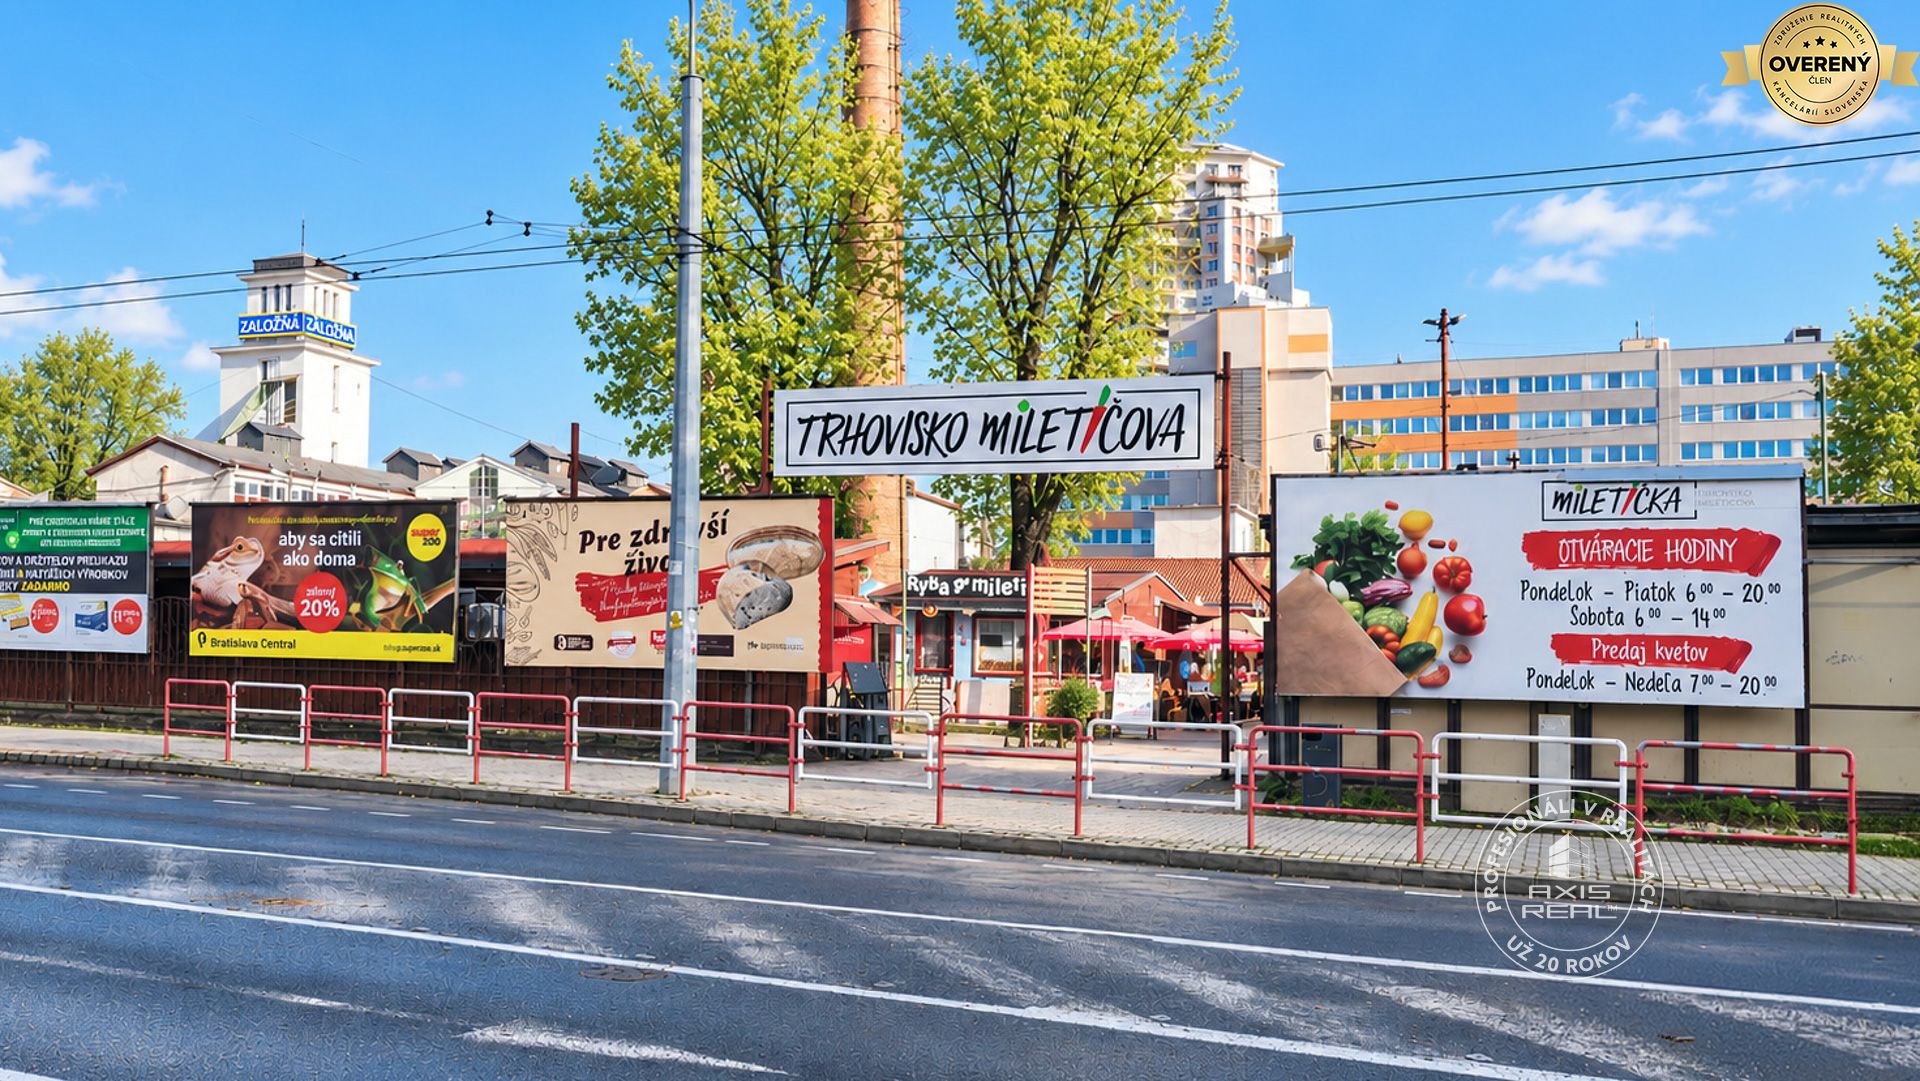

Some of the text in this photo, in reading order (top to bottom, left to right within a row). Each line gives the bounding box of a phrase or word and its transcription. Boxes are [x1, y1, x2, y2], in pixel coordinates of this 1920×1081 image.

[797, 410, 969, 458] TRHOVISKO
[278, 530, 362, 551] aby sa citili
[578, 529, 621, 554] Pre
[1558, 532, 1739, 565] OTVÁRACIE HODINY
[282, 550, 356, 567] ako doma
[1520, 579, 1593, 602] Pondelok
[1624, 580, 1676, 602] Piatok
[300, 599, 340, 617] 20%
[1570, 604, 1624, 627] Sobota
[210, 637, 296, 649] Bratislava Central
[1591, 637, 1709, 666] Predaj kvetov
[1526, 667, 1595, 691] Pondelok
